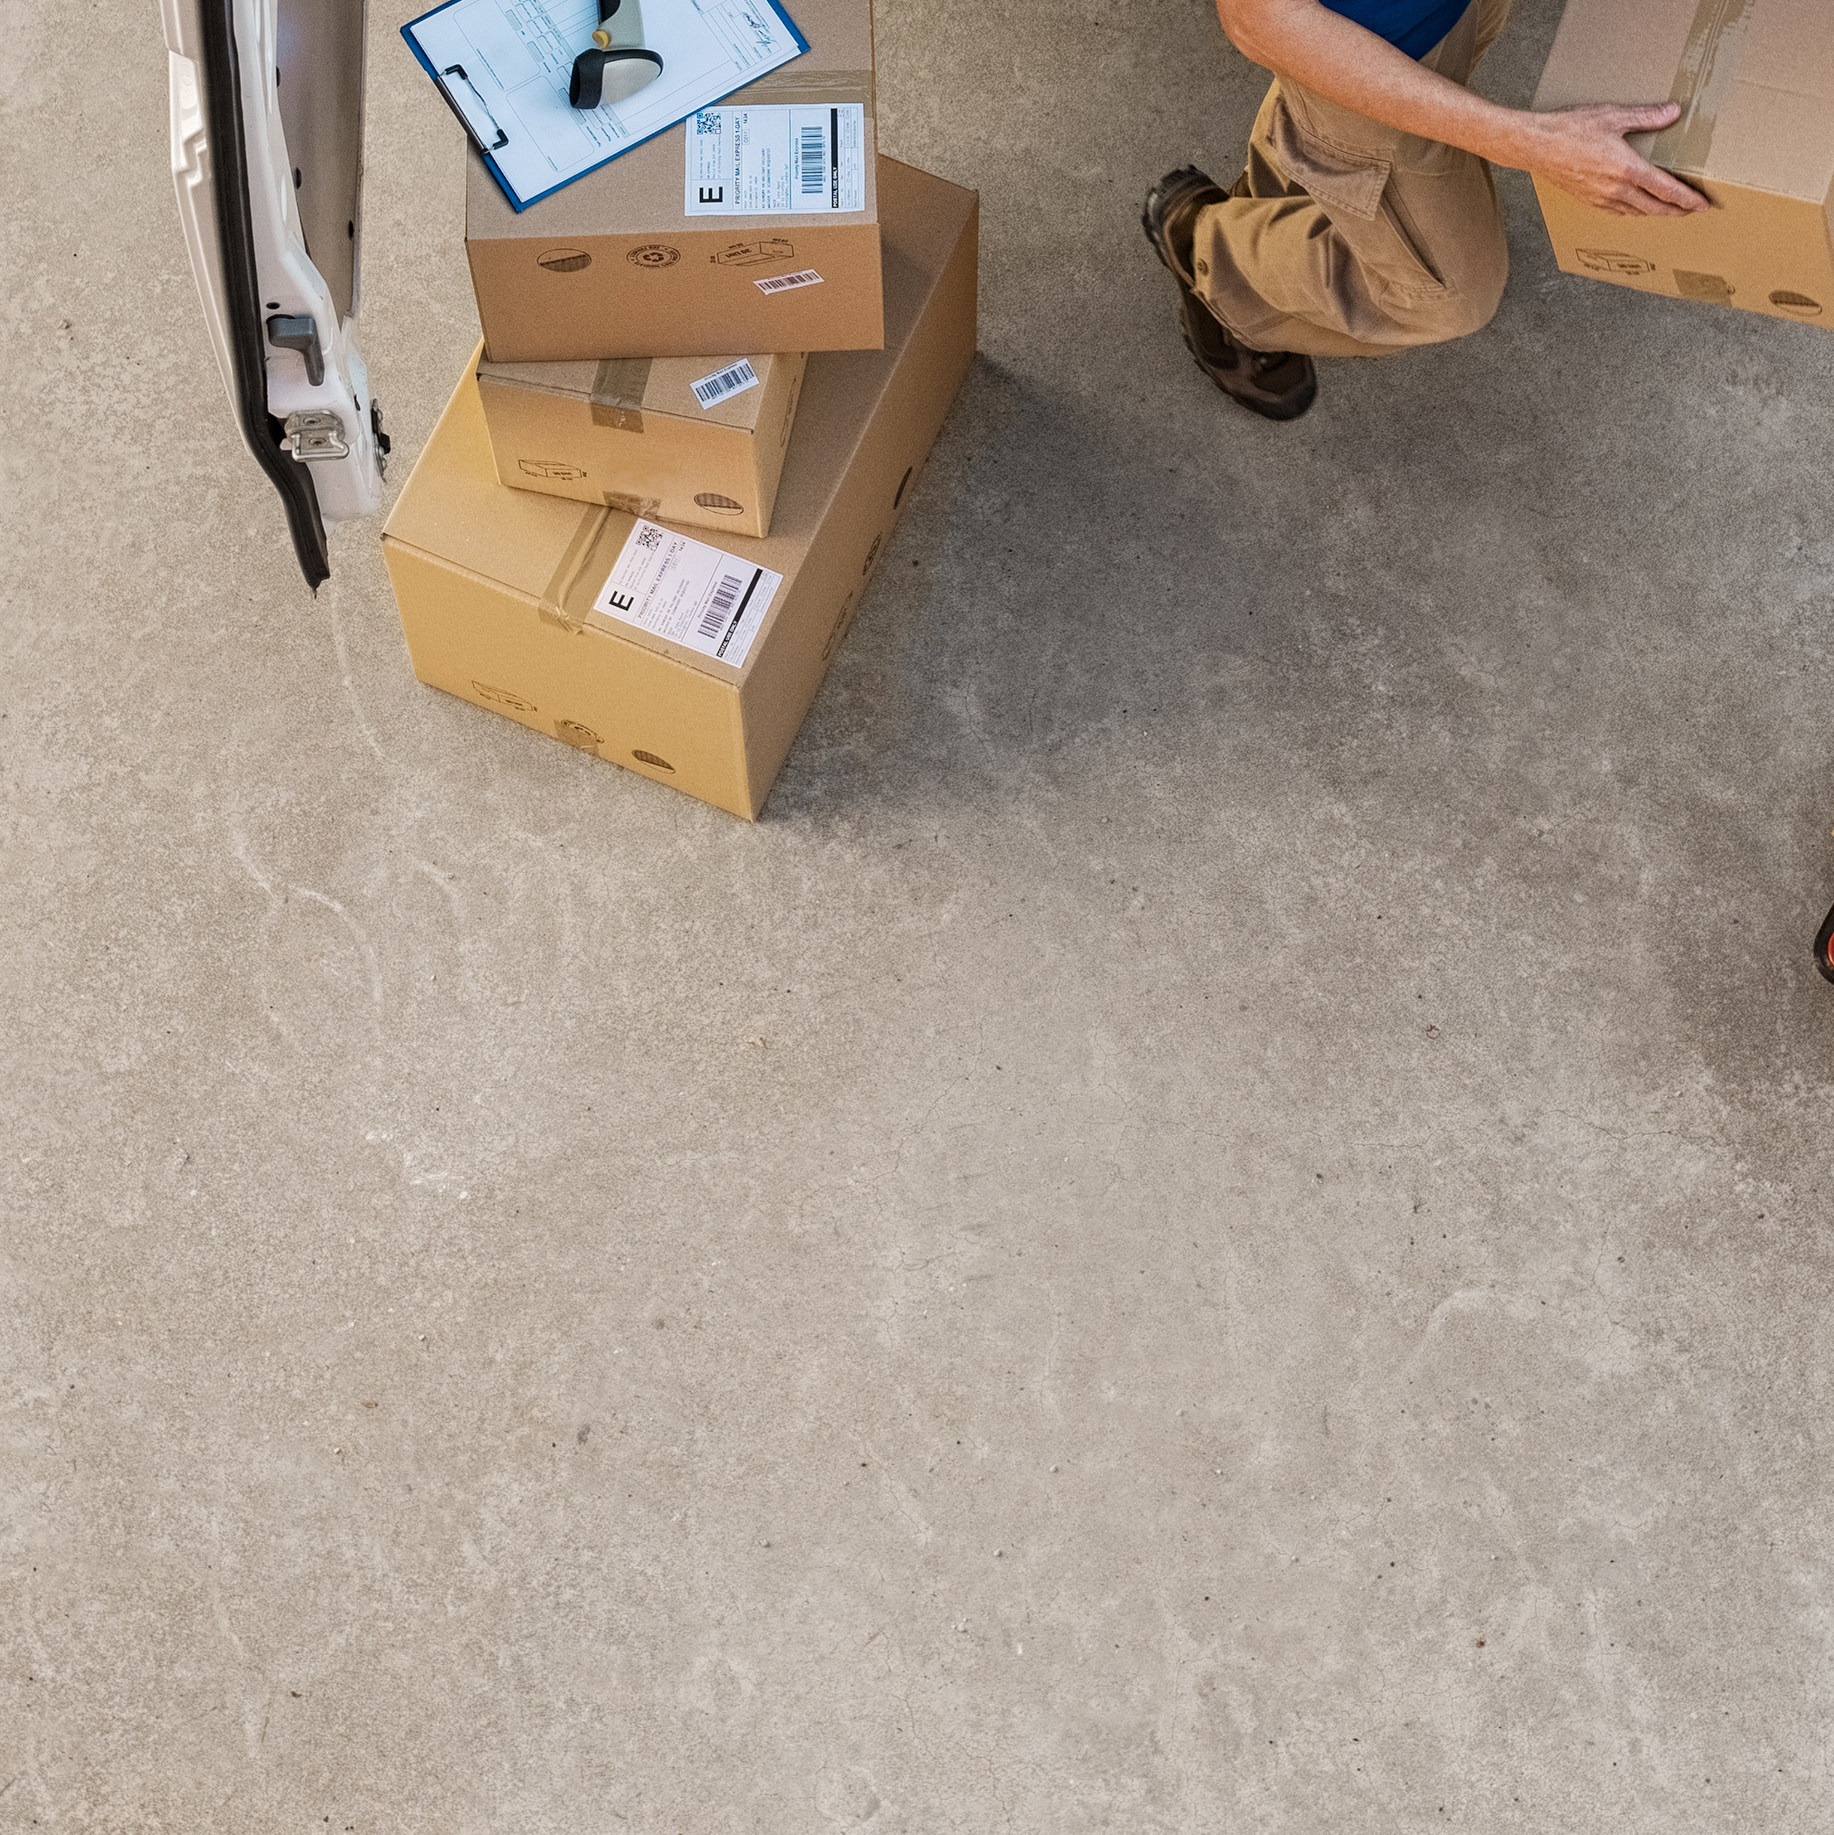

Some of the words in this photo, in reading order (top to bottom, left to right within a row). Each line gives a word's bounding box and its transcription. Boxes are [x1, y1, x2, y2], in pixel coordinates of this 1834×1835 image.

[699, 186, 723, 203] E
[636, 593, 653, 619] PRIORITY
[648, 581, 659, 594] MAIL
[655, 556, 671, 581] EXPRESS
[667, 541, 678, 557] 1-DAY
[608, 589, 635, 611] E
[717, 639, 729, 657] POSTAL
[724, 631, 732, 641] USE
[728, 619, 738, 632] ONLY
